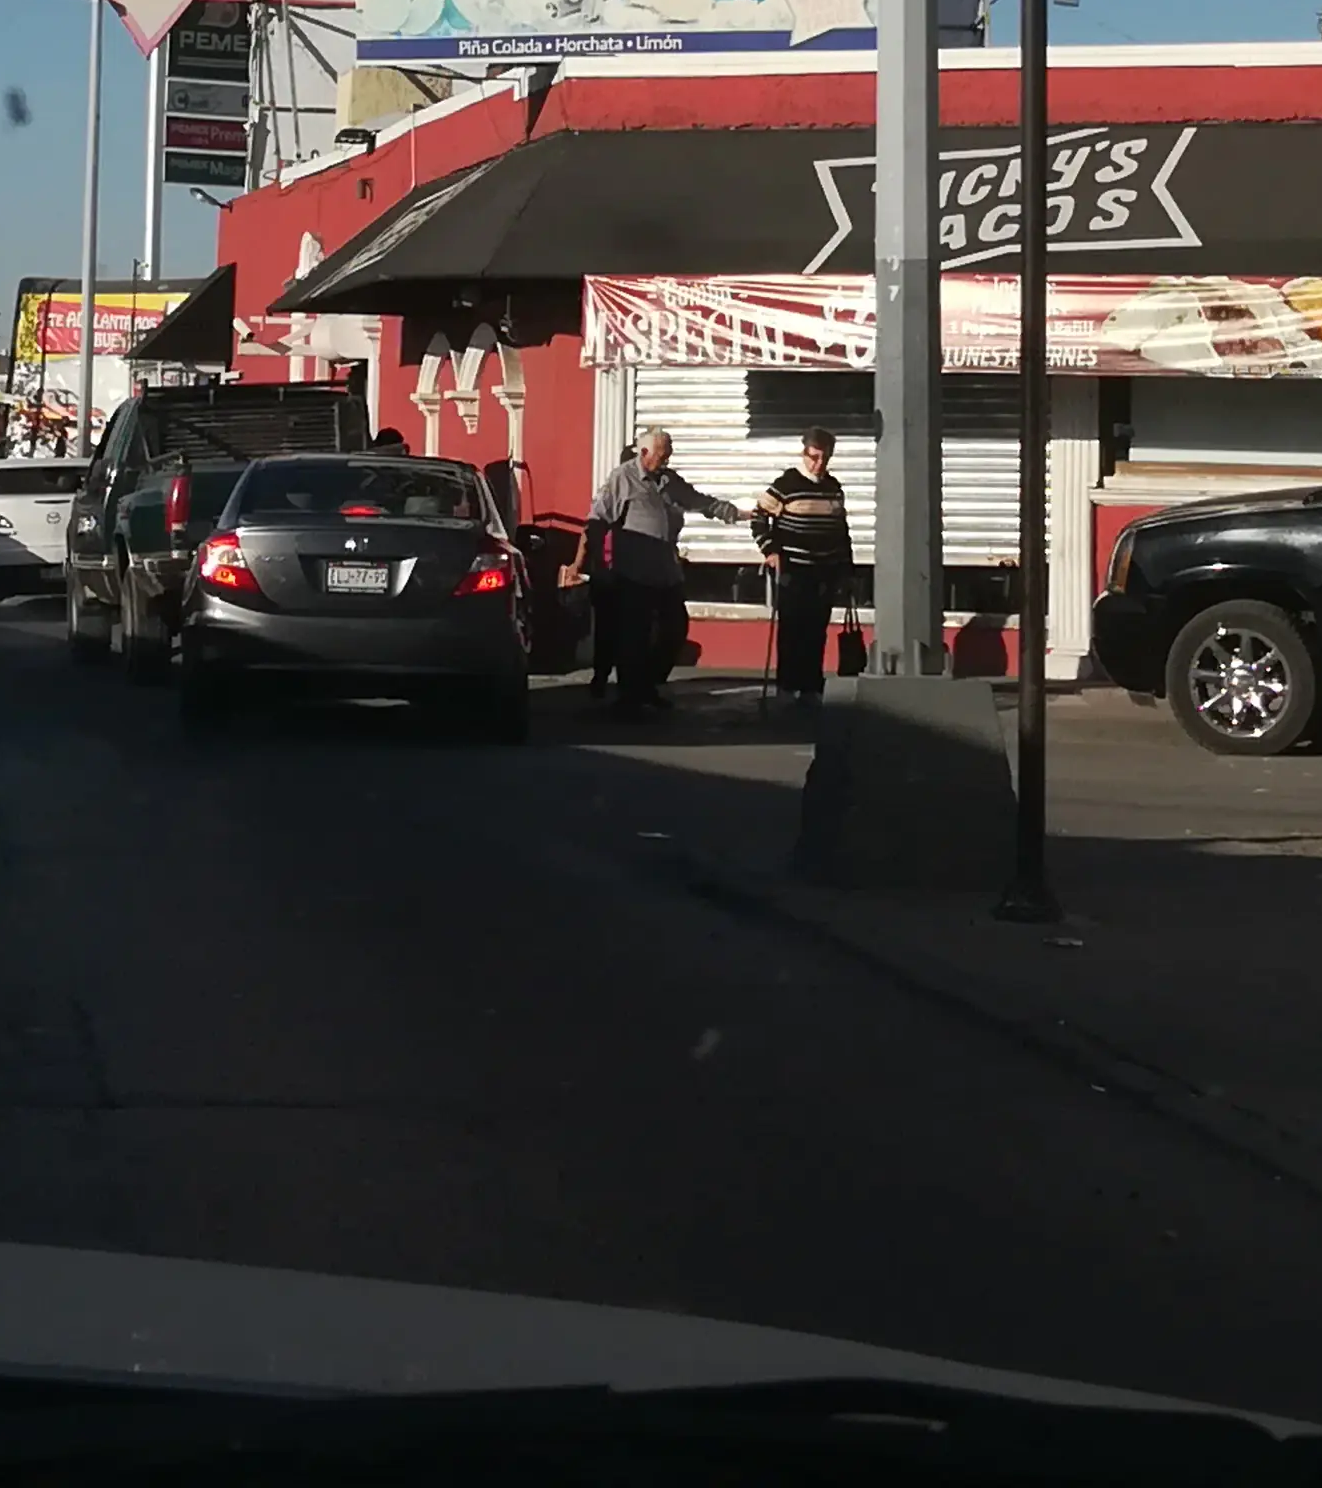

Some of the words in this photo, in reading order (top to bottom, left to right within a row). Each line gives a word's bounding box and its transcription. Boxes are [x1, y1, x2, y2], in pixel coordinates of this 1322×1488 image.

[459, 40, 488, 55] Piña
[492, 39, 542, 54] Colada
[555, 36, 624, 52] Horchata
[636, 35, 682, 50] Limón
